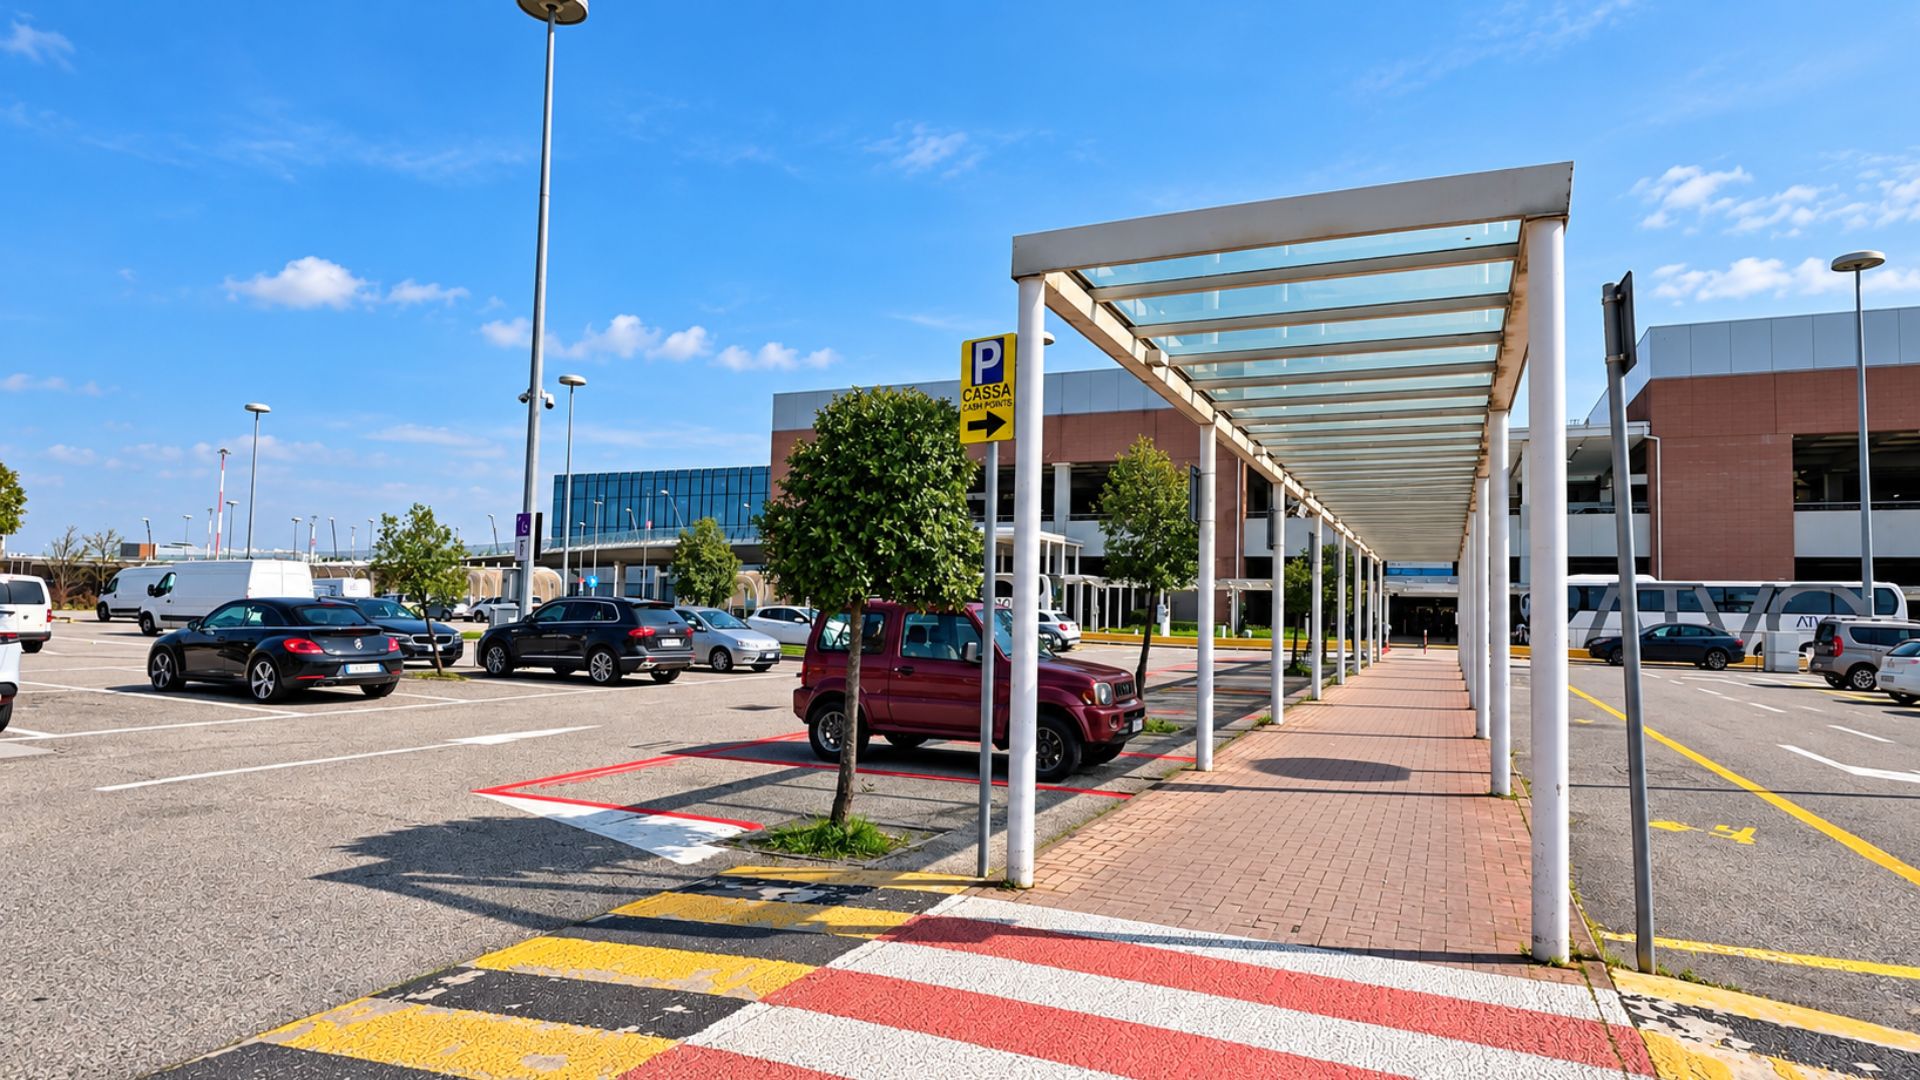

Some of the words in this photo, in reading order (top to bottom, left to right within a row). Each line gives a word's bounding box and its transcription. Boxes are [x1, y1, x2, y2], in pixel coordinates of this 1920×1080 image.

[975, 340, 1001, 384] P
[963, 384, 1011, 402] CASSA
[962, 402, 983, 412] CASH
[984, 399, 1012, 409] POINTS
